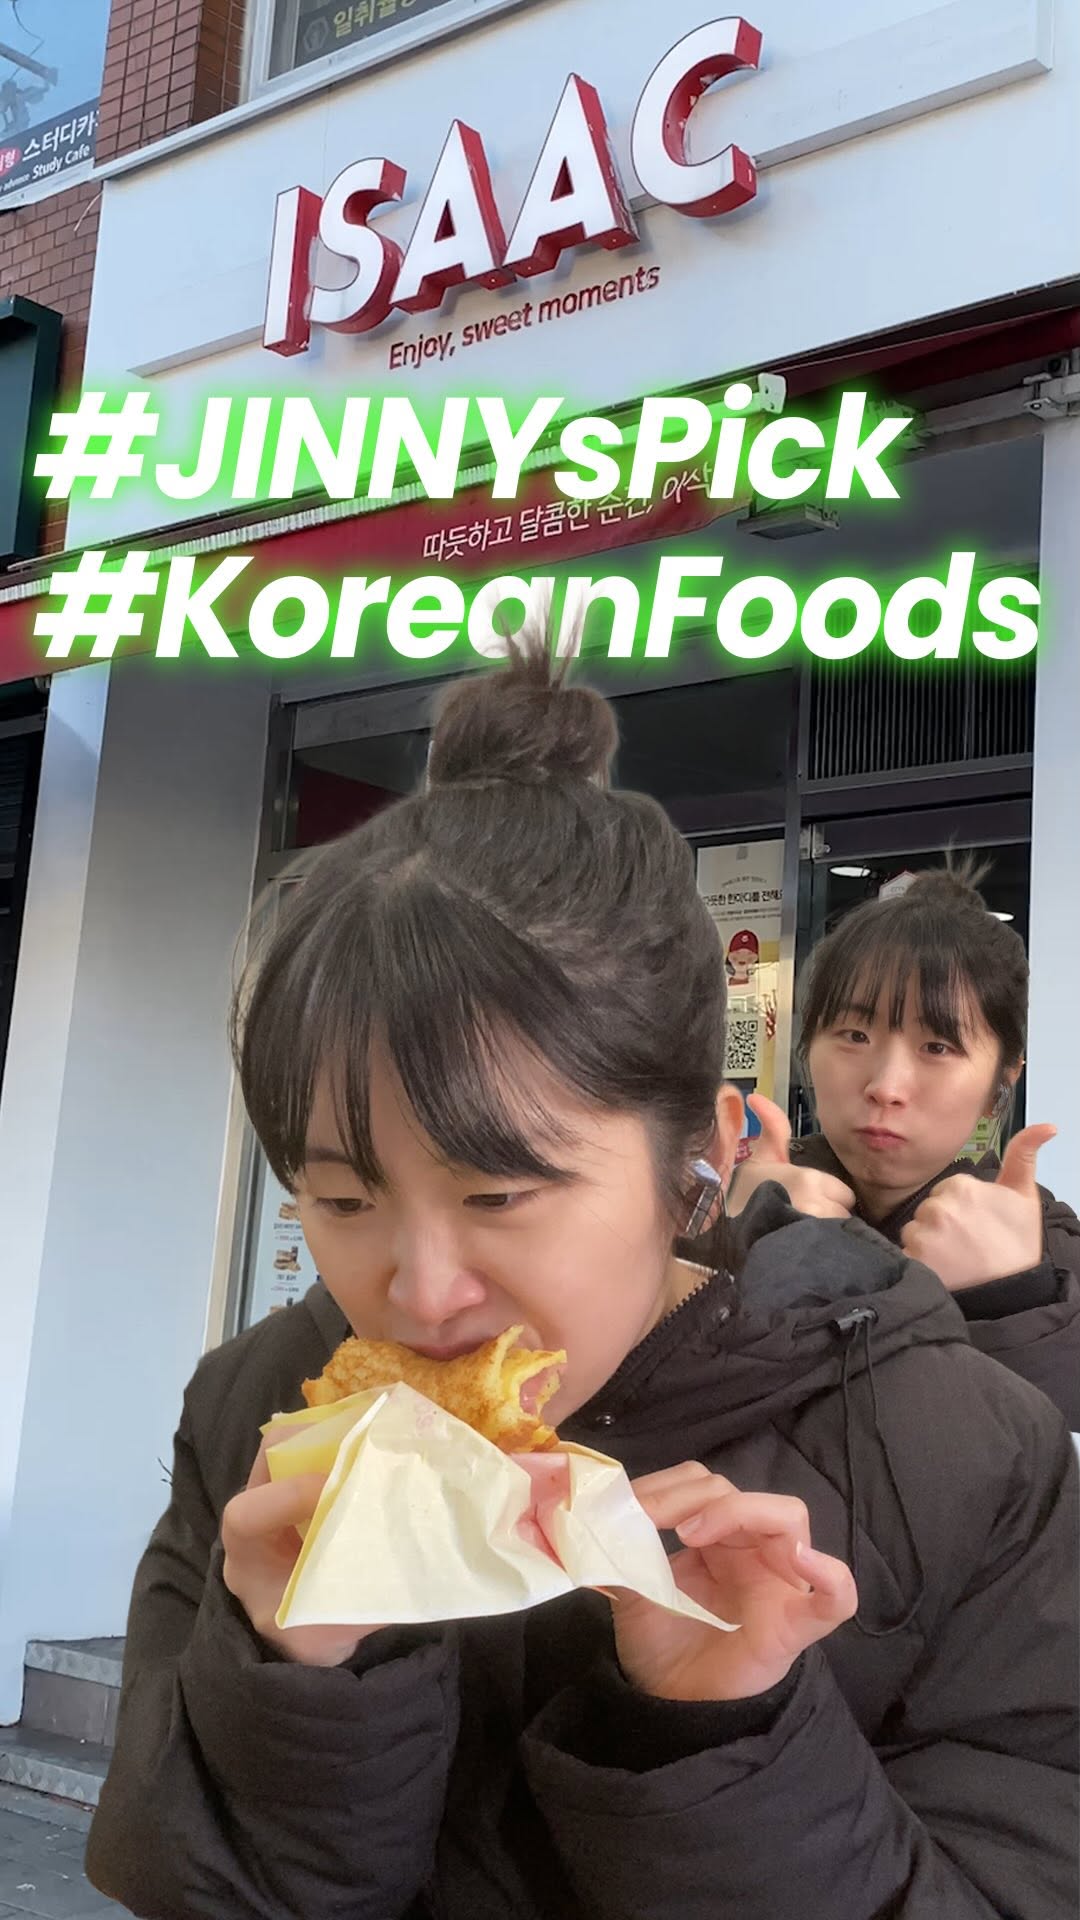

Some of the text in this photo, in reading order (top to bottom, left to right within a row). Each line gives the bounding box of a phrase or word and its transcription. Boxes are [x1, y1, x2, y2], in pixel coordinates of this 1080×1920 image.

[32, 156, 63, 179] Study
[65, 143, 90, 164] Cafe
[263, 15, 763, 358] ISAAC
[389, 265, 661, 370] Enjoy, sweet moments
[423, 516, 513, 562] 따뜻하고
[519, 498, 591, 543] 달콤한
